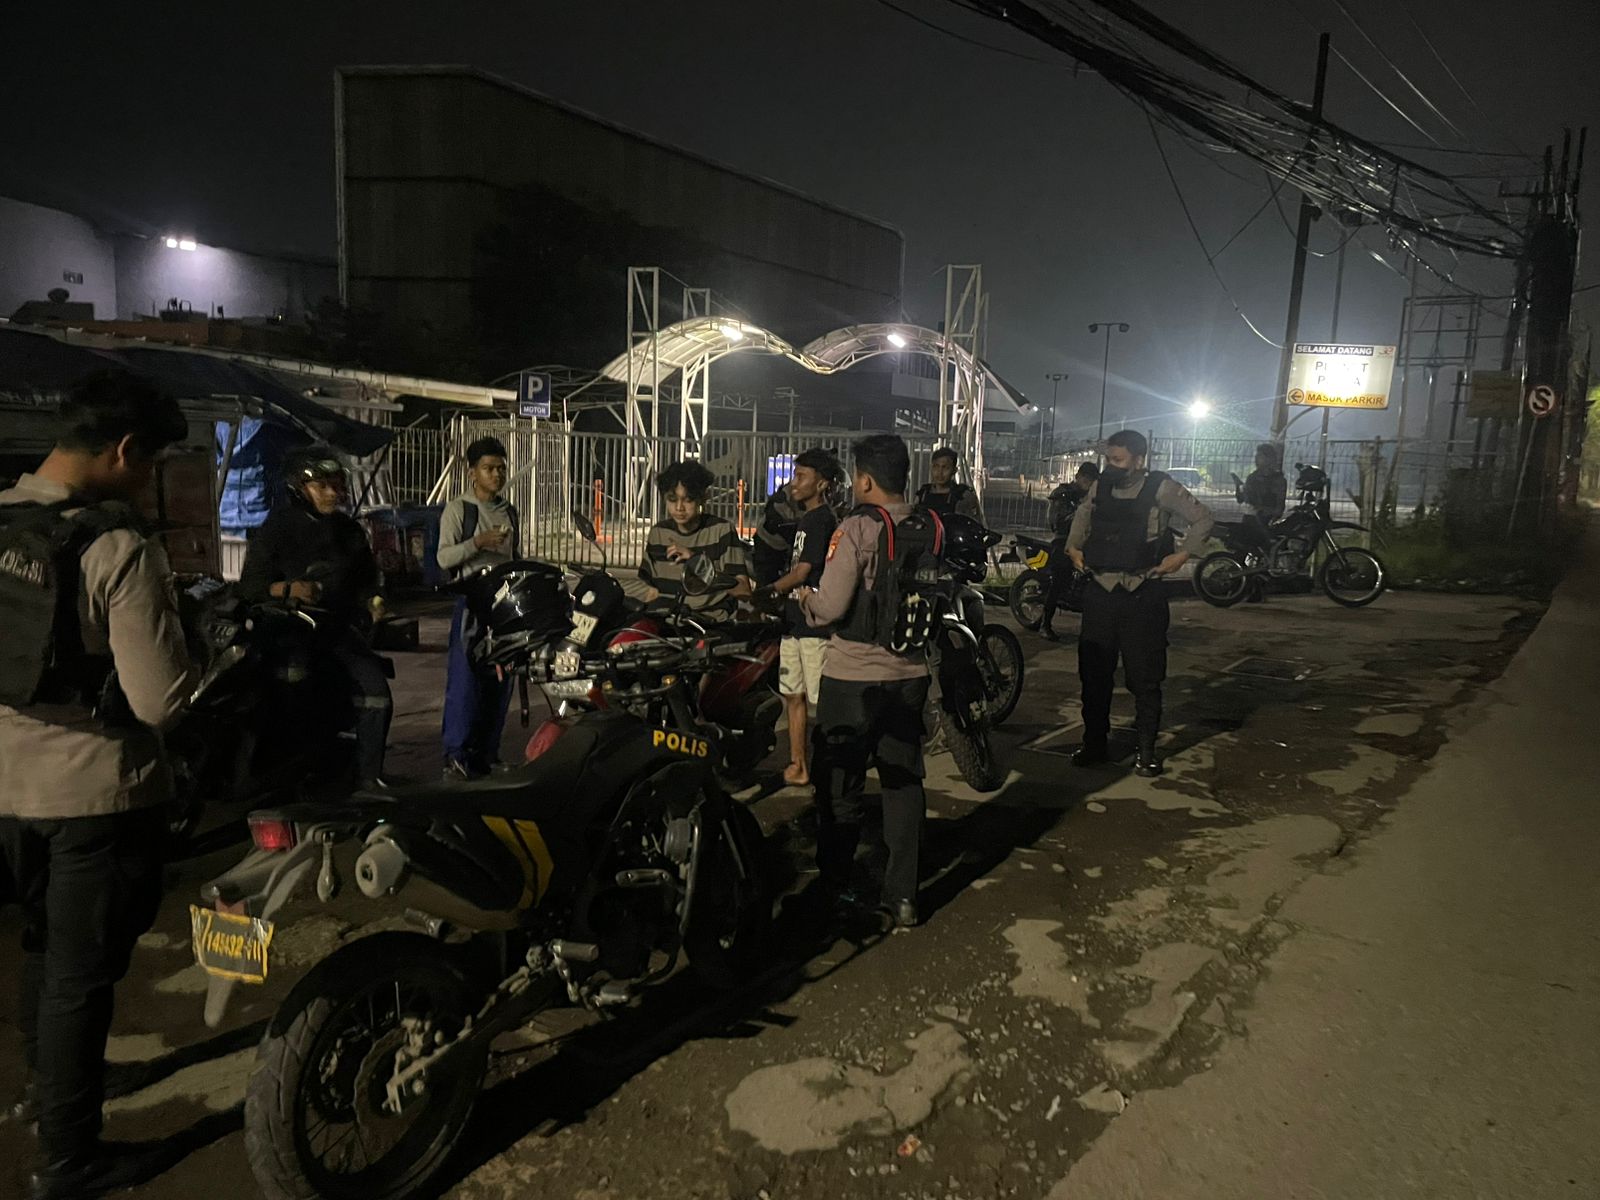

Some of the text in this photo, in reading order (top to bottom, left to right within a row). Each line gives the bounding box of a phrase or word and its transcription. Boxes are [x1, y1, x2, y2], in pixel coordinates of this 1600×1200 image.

[1296, 345, 1336, 355] SELAMAT
[1337, 346, 1373, 356] DATANG
[527, 375, 544, 401] P
[1345, 395, 1385, 406] PARKIR
[523, 405, 546, 415] MOTOR
[652, 729, 709, 758] POLIS
